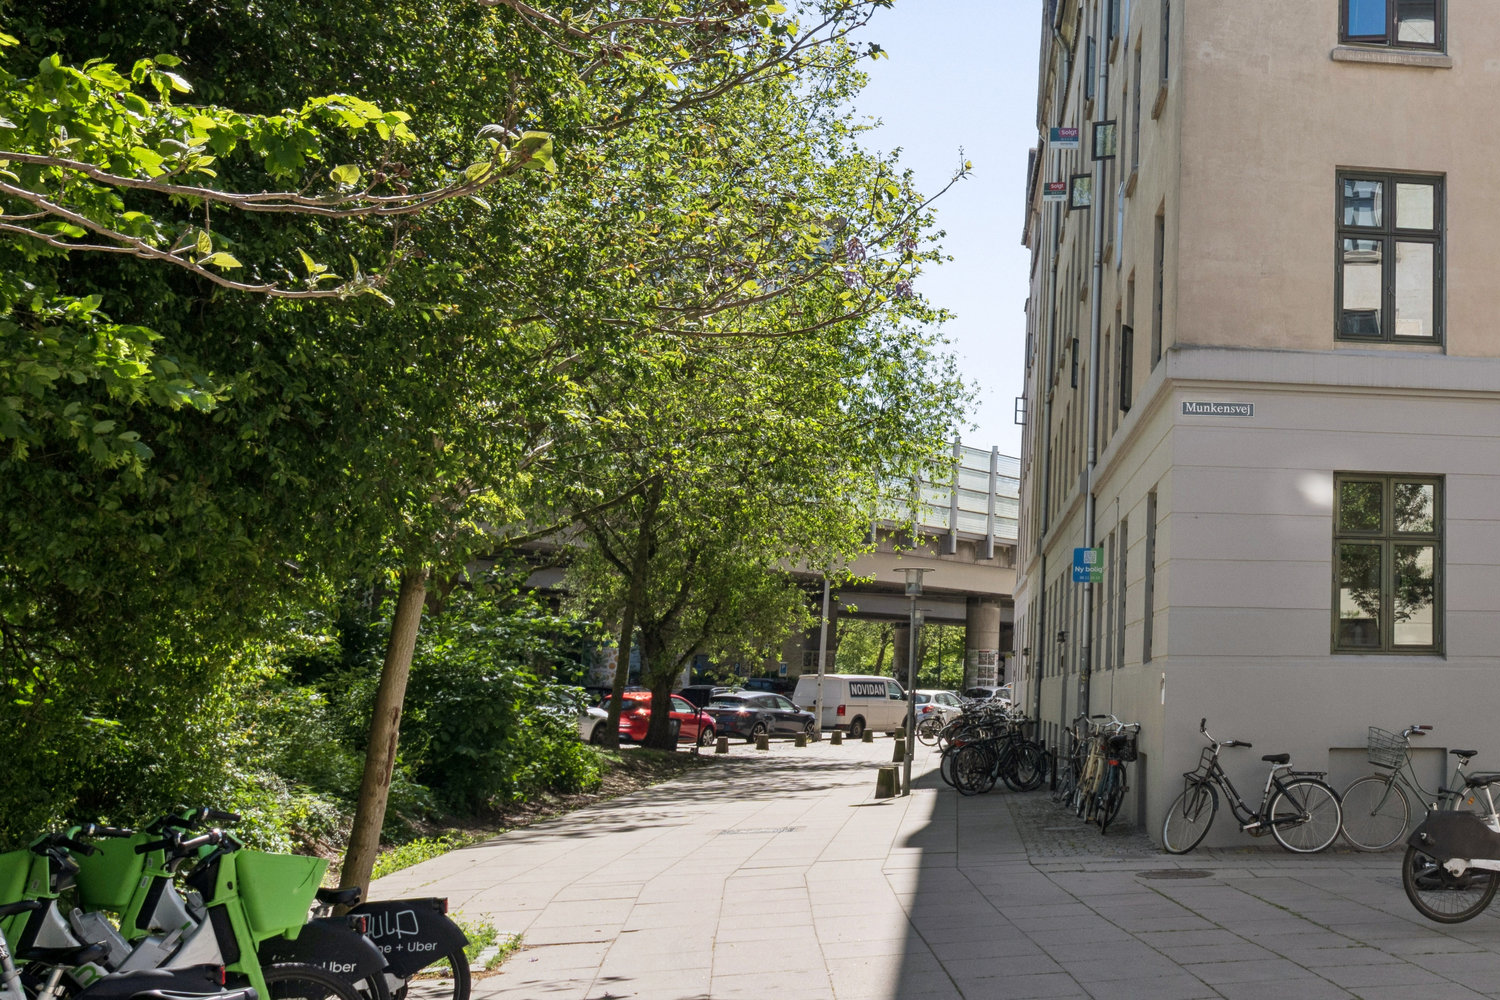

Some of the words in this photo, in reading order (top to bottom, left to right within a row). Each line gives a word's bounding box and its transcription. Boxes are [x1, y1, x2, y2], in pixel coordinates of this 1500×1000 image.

[1185, 402, 1251, 416] Munkensvej
[850, 683, 885, 696] NOVIDAN
[407, 941, 438, 953] Uber
